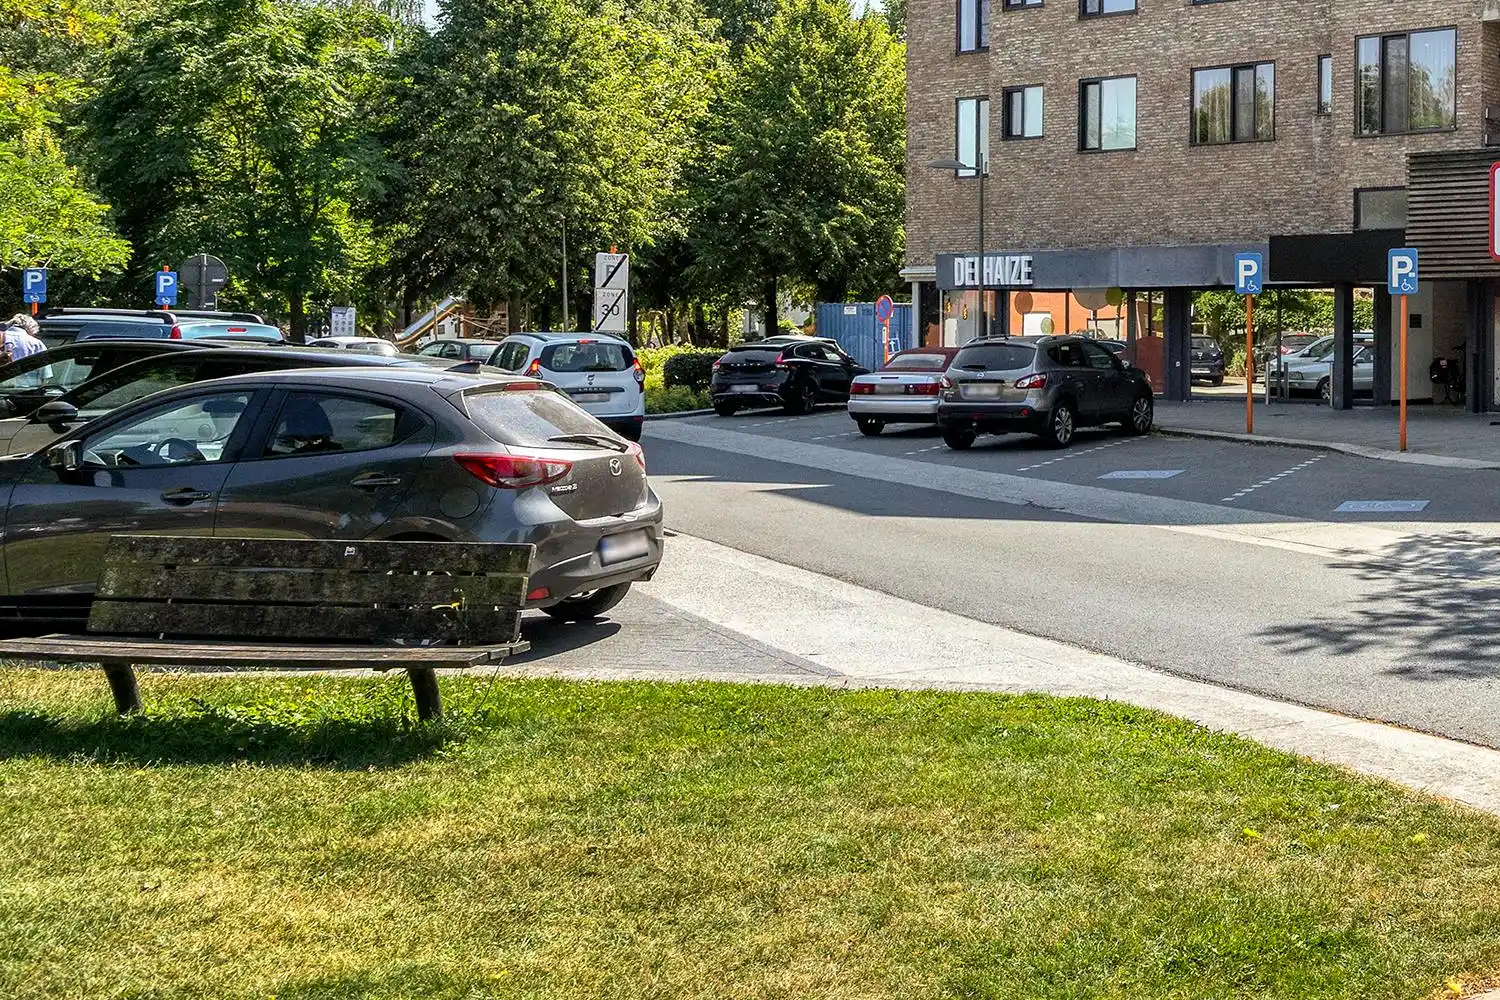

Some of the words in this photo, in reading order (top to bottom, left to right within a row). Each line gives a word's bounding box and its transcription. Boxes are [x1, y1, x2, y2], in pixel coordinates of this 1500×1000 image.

[26, 271, 43, 290] P
[954, 255, 1033, 286] DELHAIZE
[1238, 259, 1258, 288] P
[1391, 255, 1413, 288] P
[159, 275, 175, 293] P
[601, 303, 620, 316] 30
